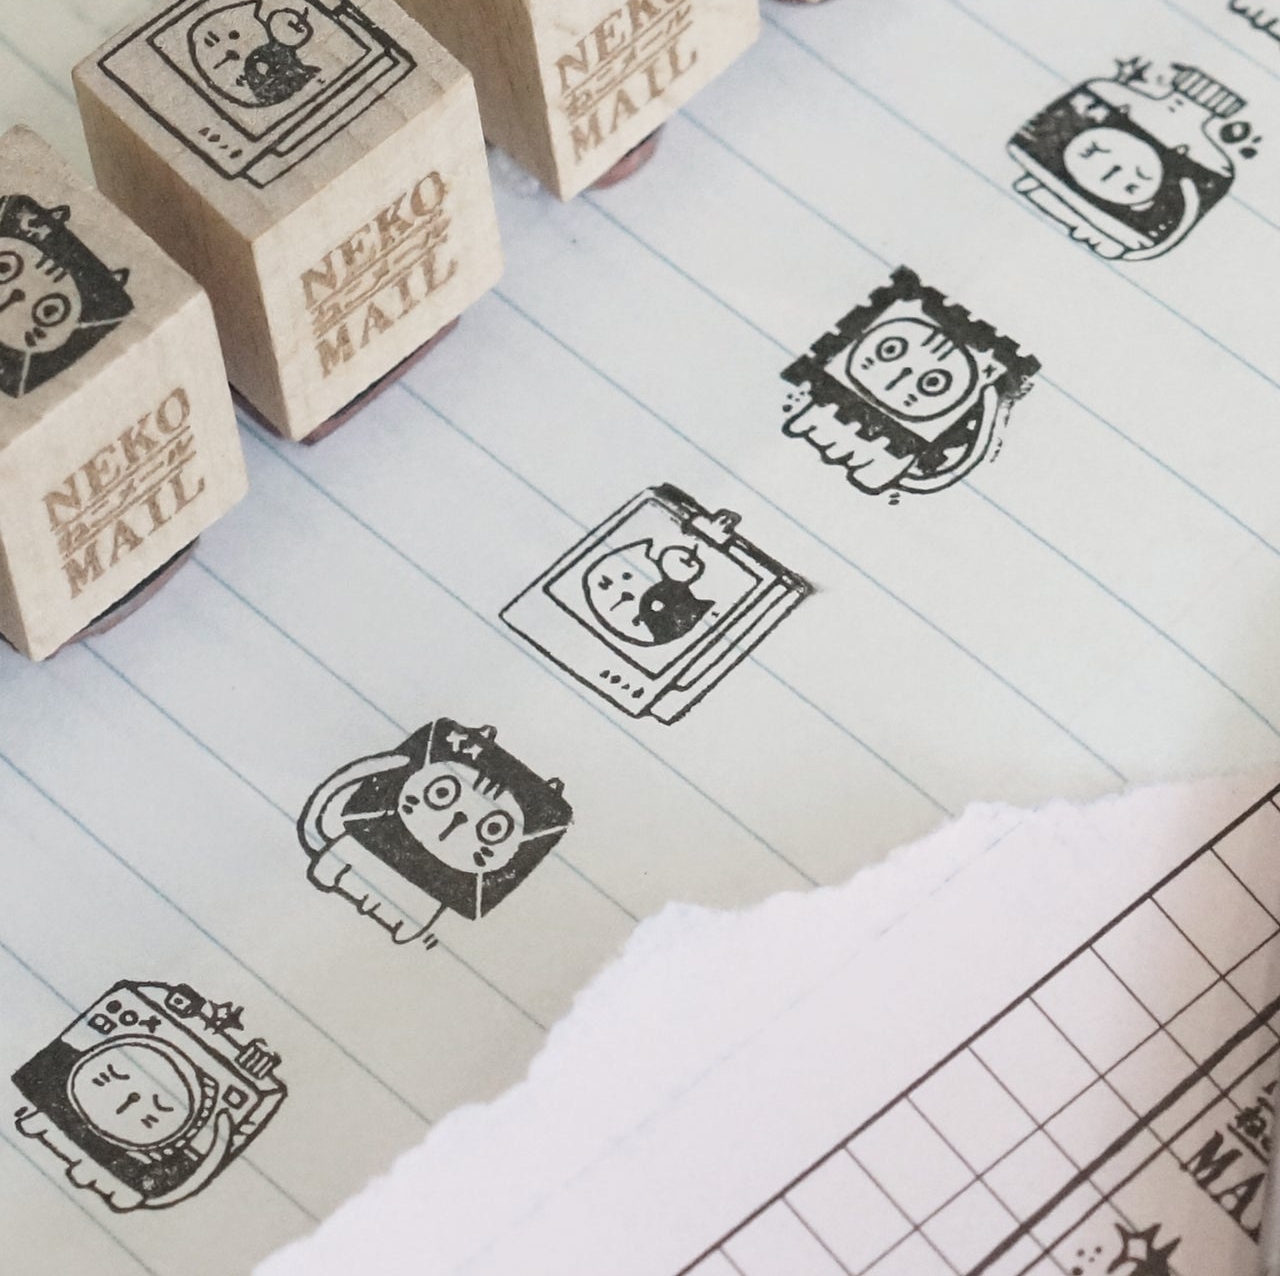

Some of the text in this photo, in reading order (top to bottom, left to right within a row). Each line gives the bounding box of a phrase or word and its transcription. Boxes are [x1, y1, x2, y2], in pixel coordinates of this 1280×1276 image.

[567, 40, 698, 169] MAIL
[300, 170, 449, 310] NEKO
[317, 255, 459, 378] MAIL
[40, 385, 192, 527] NEKO
[57, 471, 206, 602] MAIL
